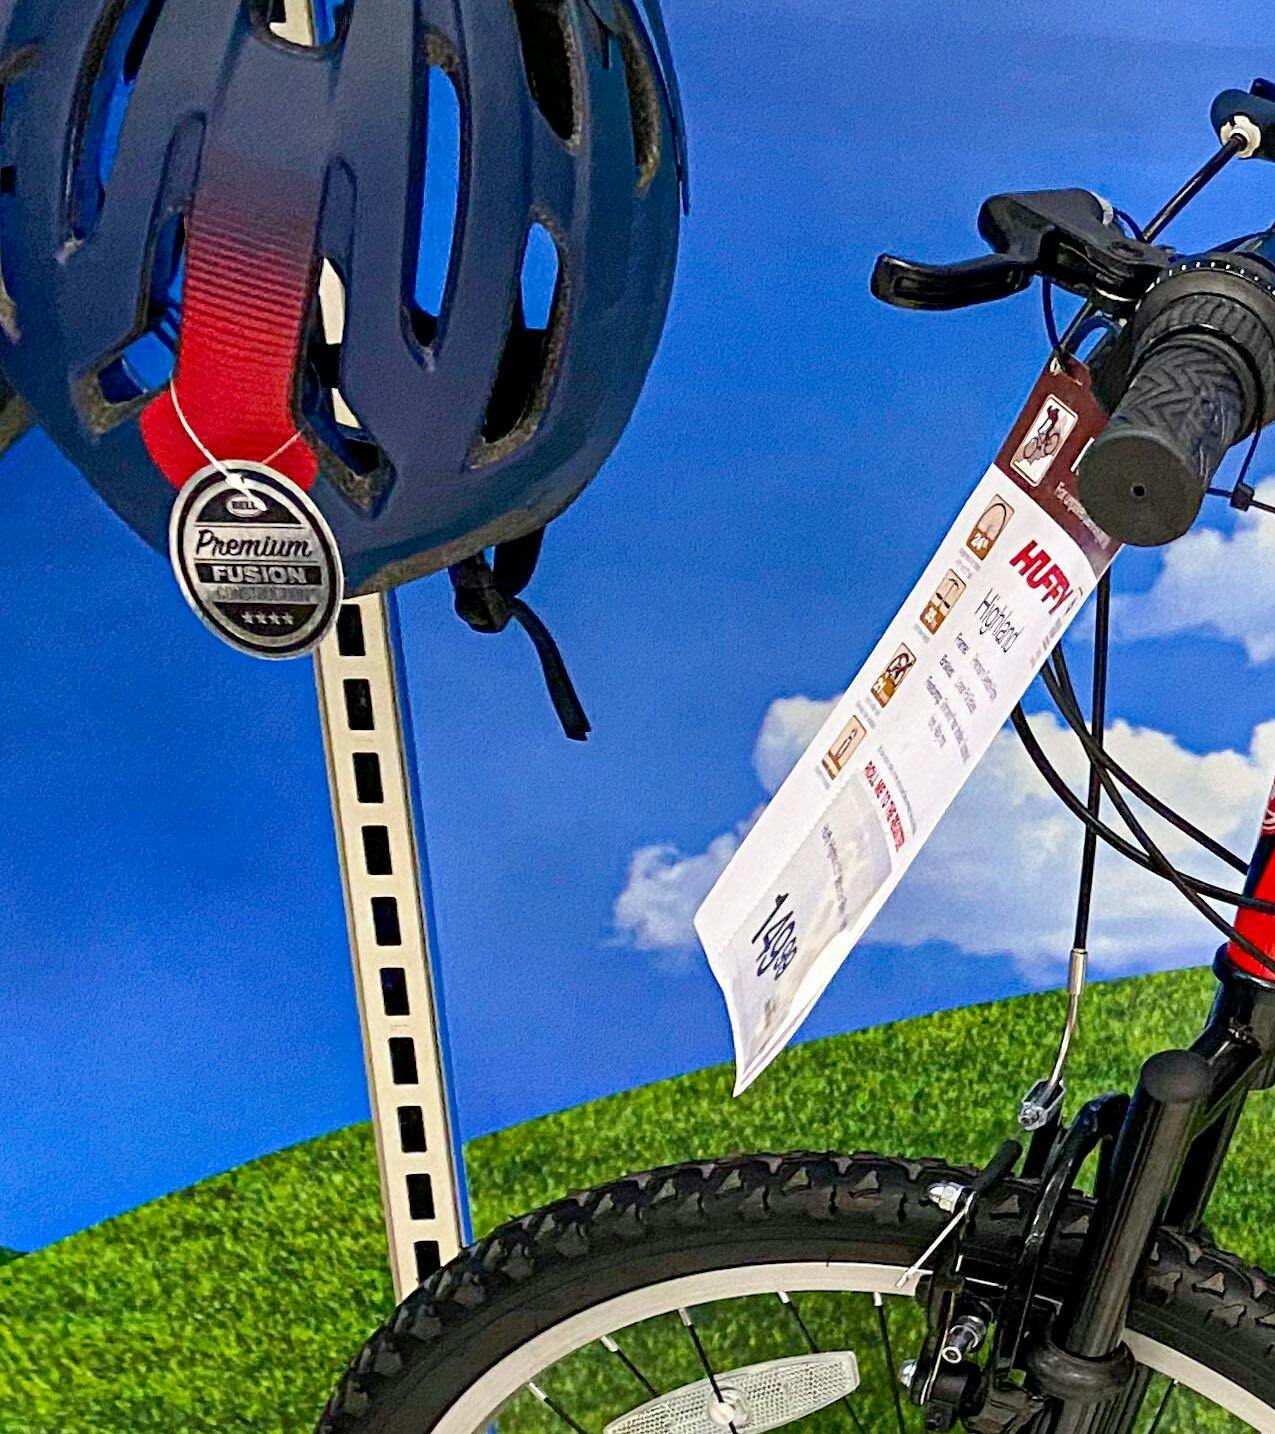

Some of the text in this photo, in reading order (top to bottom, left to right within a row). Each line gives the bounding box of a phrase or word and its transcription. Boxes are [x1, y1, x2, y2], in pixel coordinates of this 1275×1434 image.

[196, 529, 314, 558] Premium
[211, 565, 307, 584] FUSION
[1009, 540, 1073, 615] HUFFY
[974, 588, 1024, 653] Highland
